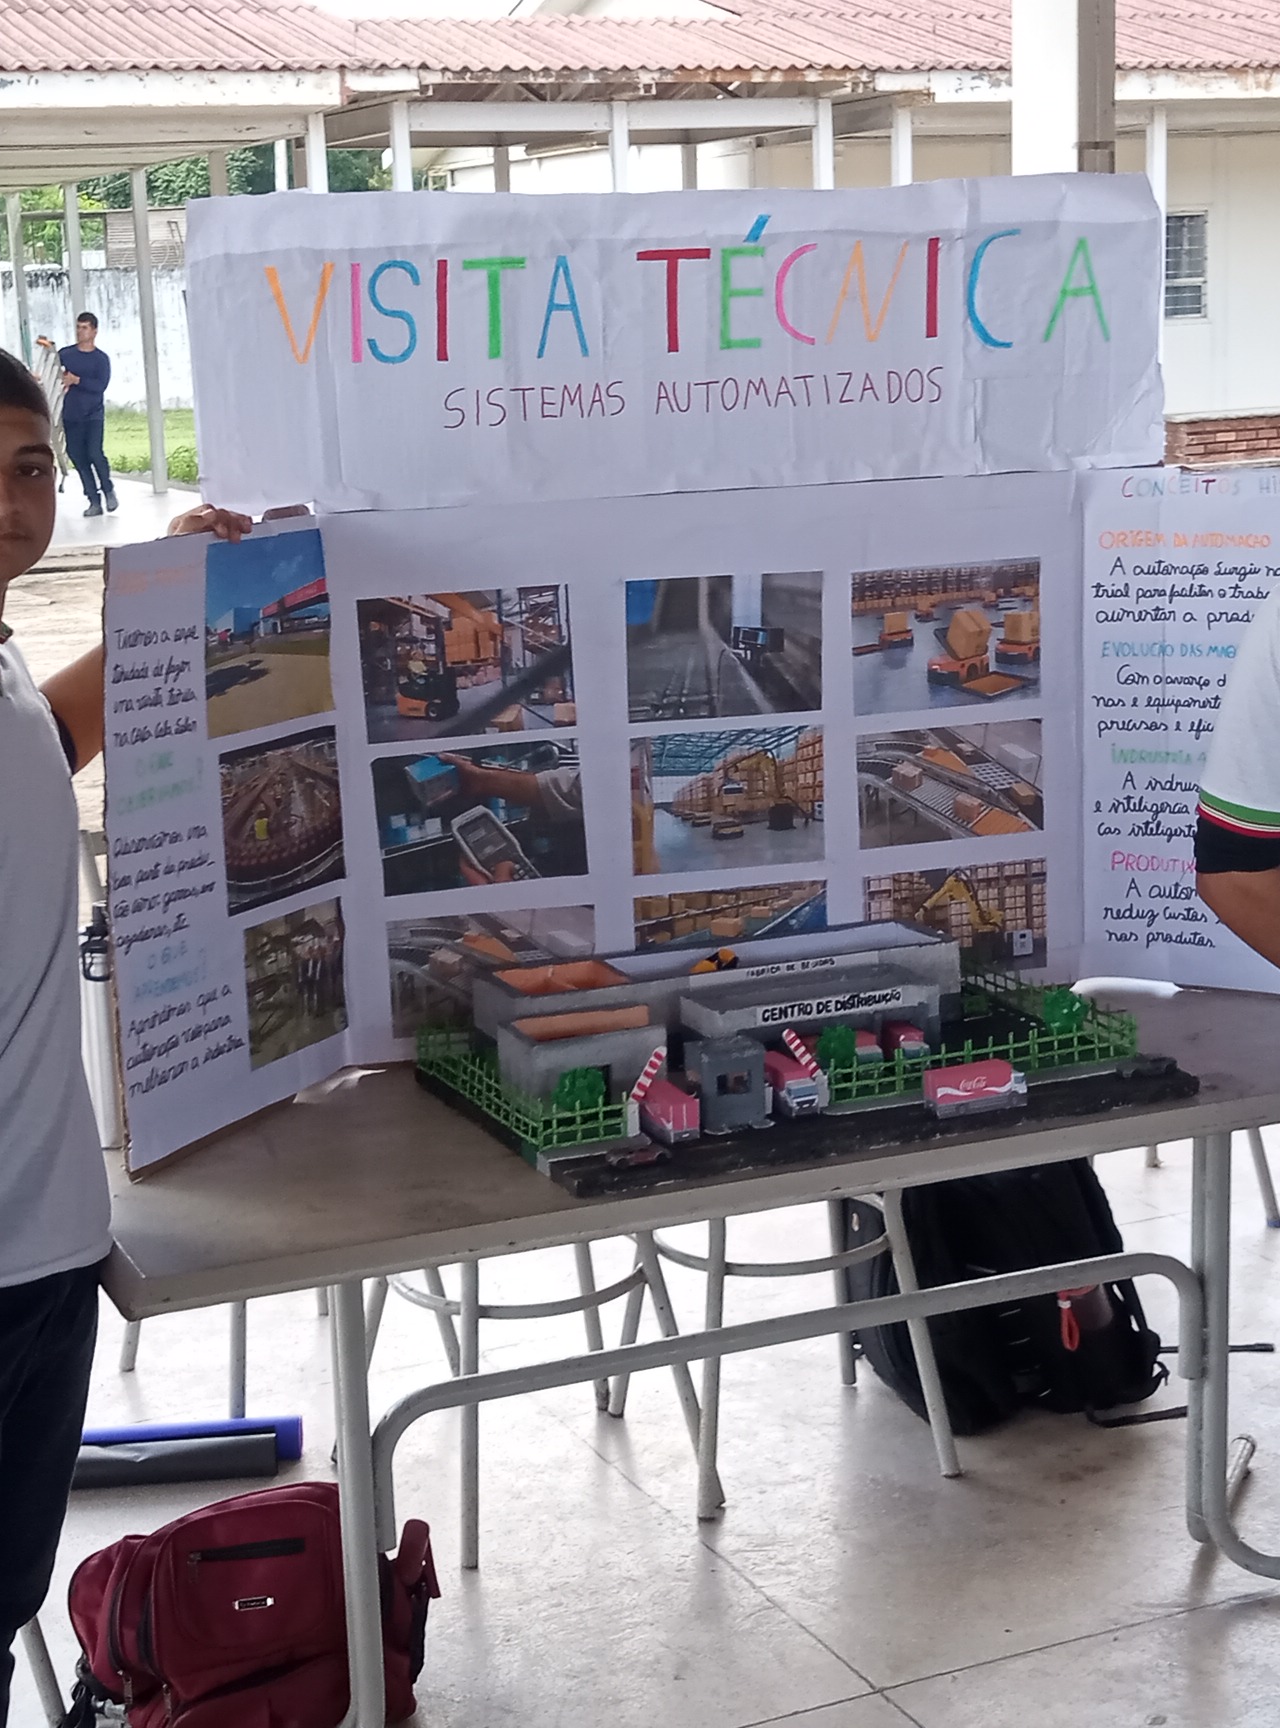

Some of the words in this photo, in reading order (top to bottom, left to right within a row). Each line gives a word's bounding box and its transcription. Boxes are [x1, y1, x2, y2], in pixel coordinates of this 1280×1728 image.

[264, 255, 590, 365] VISITA
[636, 214, 1111, 353] TÉCNICA
[443, 380, 626, 429] SISTEMAS
[655, 366, 944, 414] AUTOMATIZADOS
[1121, 475, 1240, 498] CONCEITOS
[1110, 556, 1126, 576] A
[1095, 606, 1176, 623] aumentar
[1182, 611, 1197, 623] a
[1117, 664, 1149, 686] Com
[1091, 695, 1126, 708] nas
[1131, 697, 1139, 708] e
[1174, 721, 1182, 731] e
[1122, 771, 1136, 790] A
[1145, 773, 1200, 793] indrus
[1093, 800, 1102, 813] e
[1126, 877, 1142, 898] A
[762, 1002, 813, 1022] CENTRO
[816, 999, 833, 1015] DE
